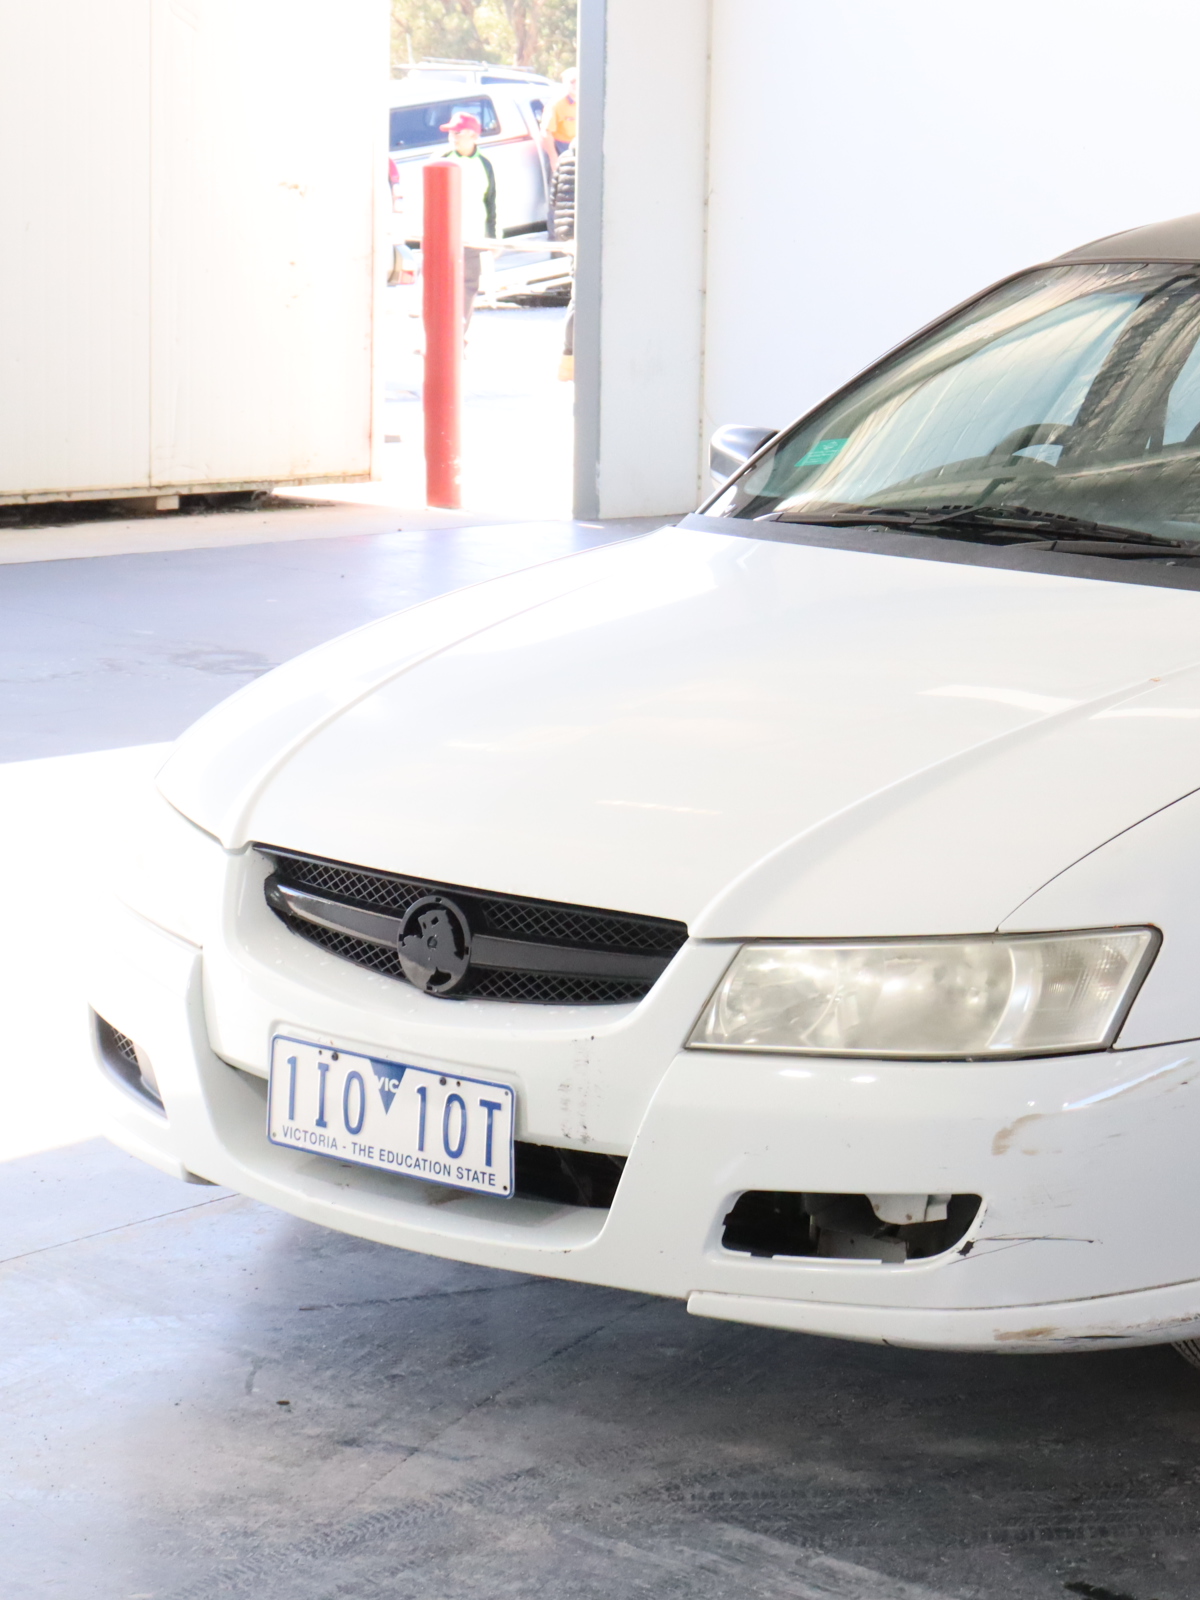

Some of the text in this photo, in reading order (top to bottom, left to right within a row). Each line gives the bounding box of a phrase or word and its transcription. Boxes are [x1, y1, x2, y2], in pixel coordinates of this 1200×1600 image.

[378, 1076, 400, 1094] VIC
[282, 1125, 338, 1150] VICTORIA
[351, 1142, 374, 1159] THE
[379, 1149, 452, 1177] EDUCATION
[456, 1167, 497, 1187] STATE
